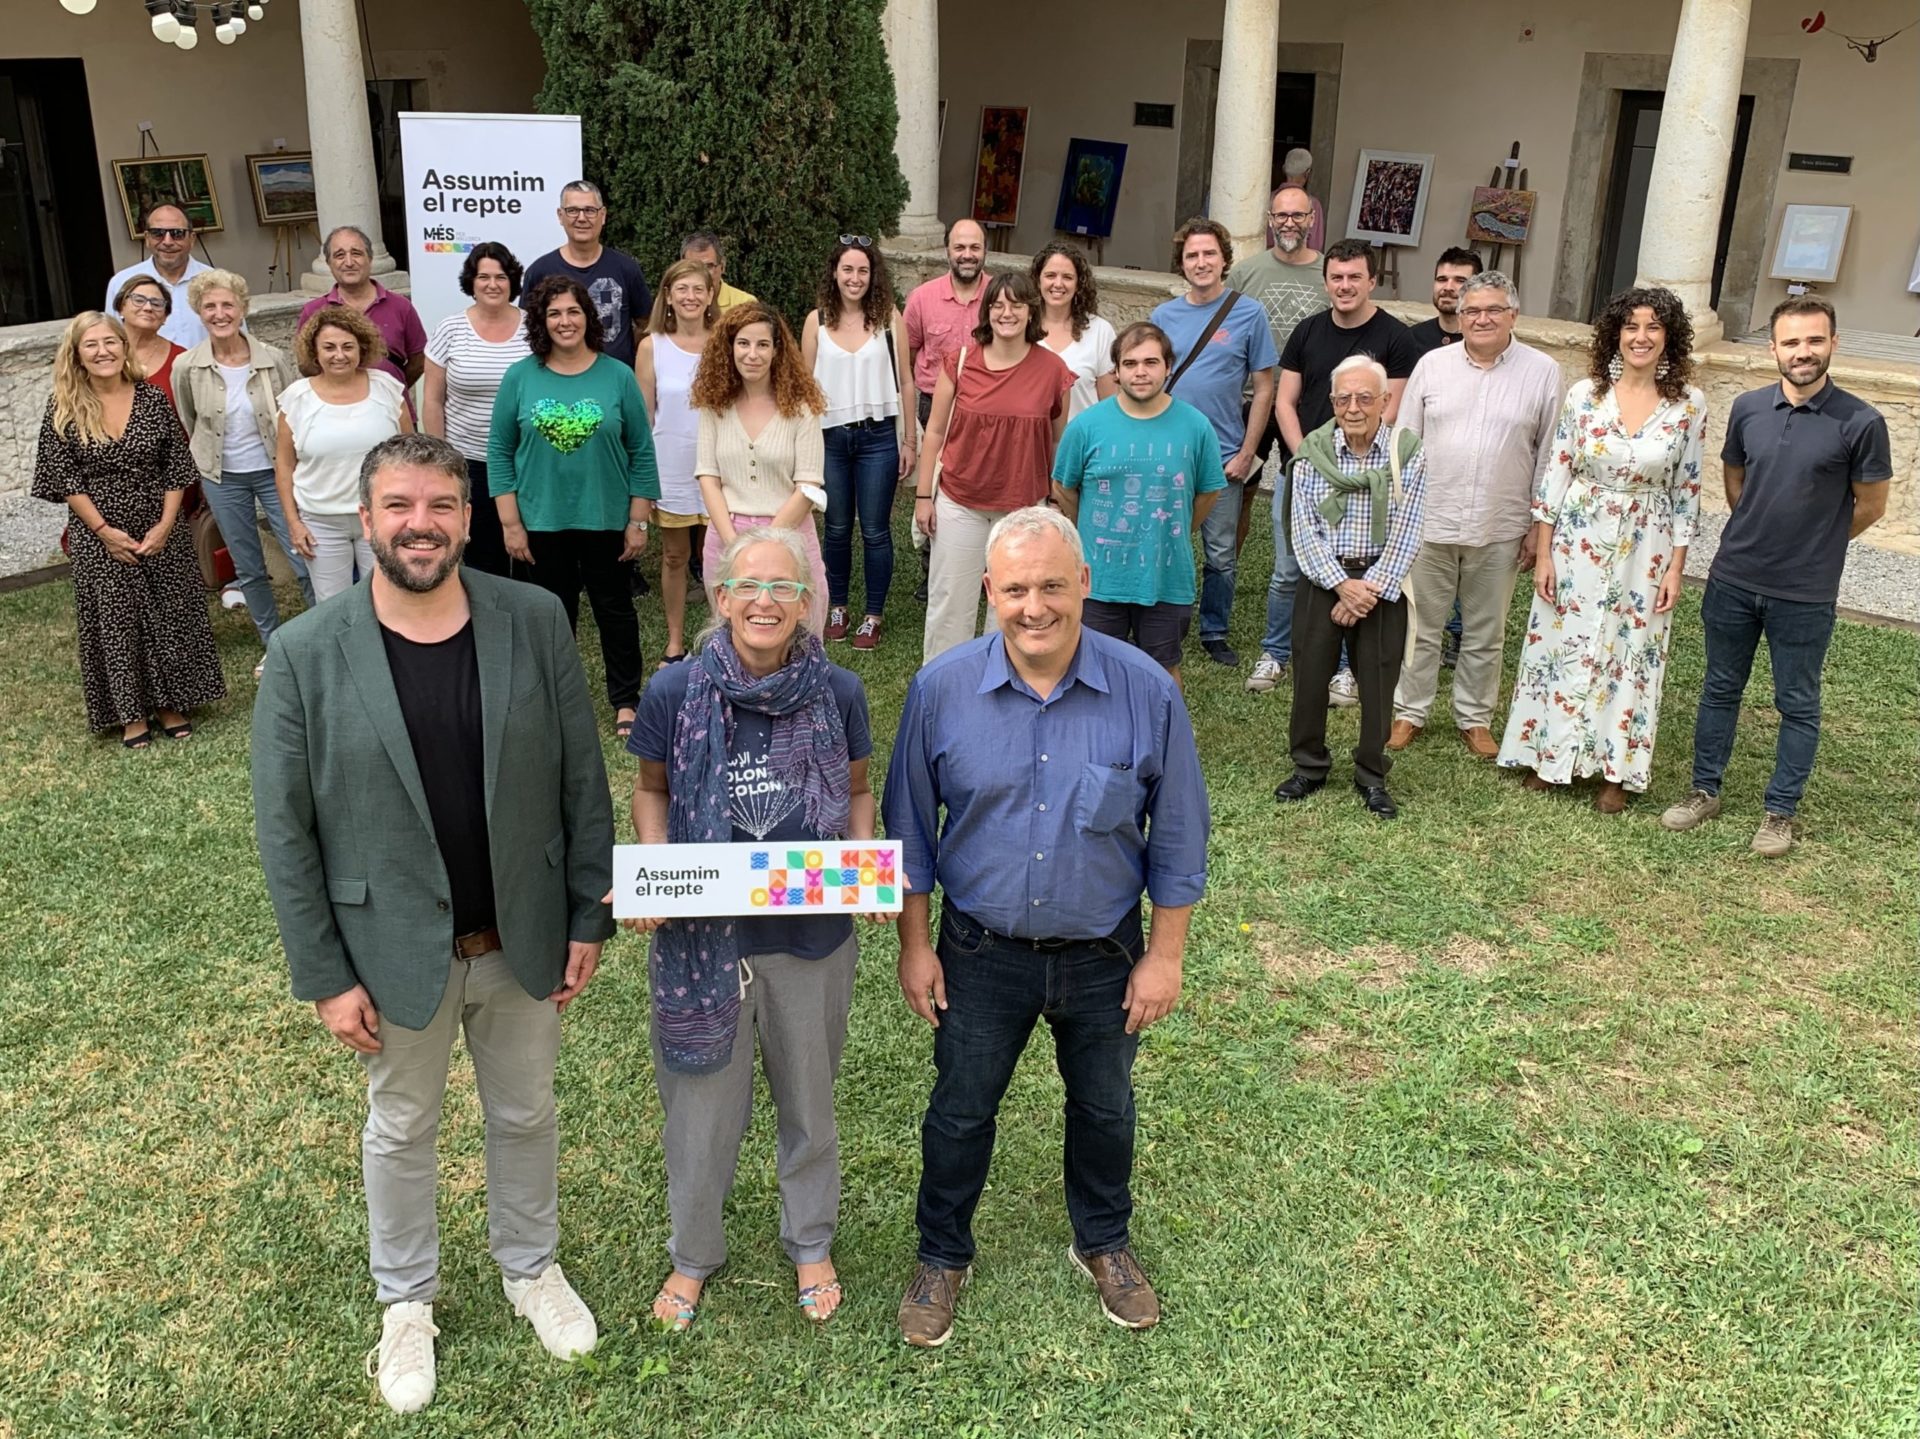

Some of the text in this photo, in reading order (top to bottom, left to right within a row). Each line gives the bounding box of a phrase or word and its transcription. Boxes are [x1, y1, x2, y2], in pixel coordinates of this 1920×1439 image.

[422, 168, 545, 192] Assumim
[423, 192, 522, 218] el repte
[424, 224, 455, 241] MÉS
[727, 767, 768, 783] OLON
[635, 866, 720, 882] Assumim
[636, 882, 704, 898] el repte
